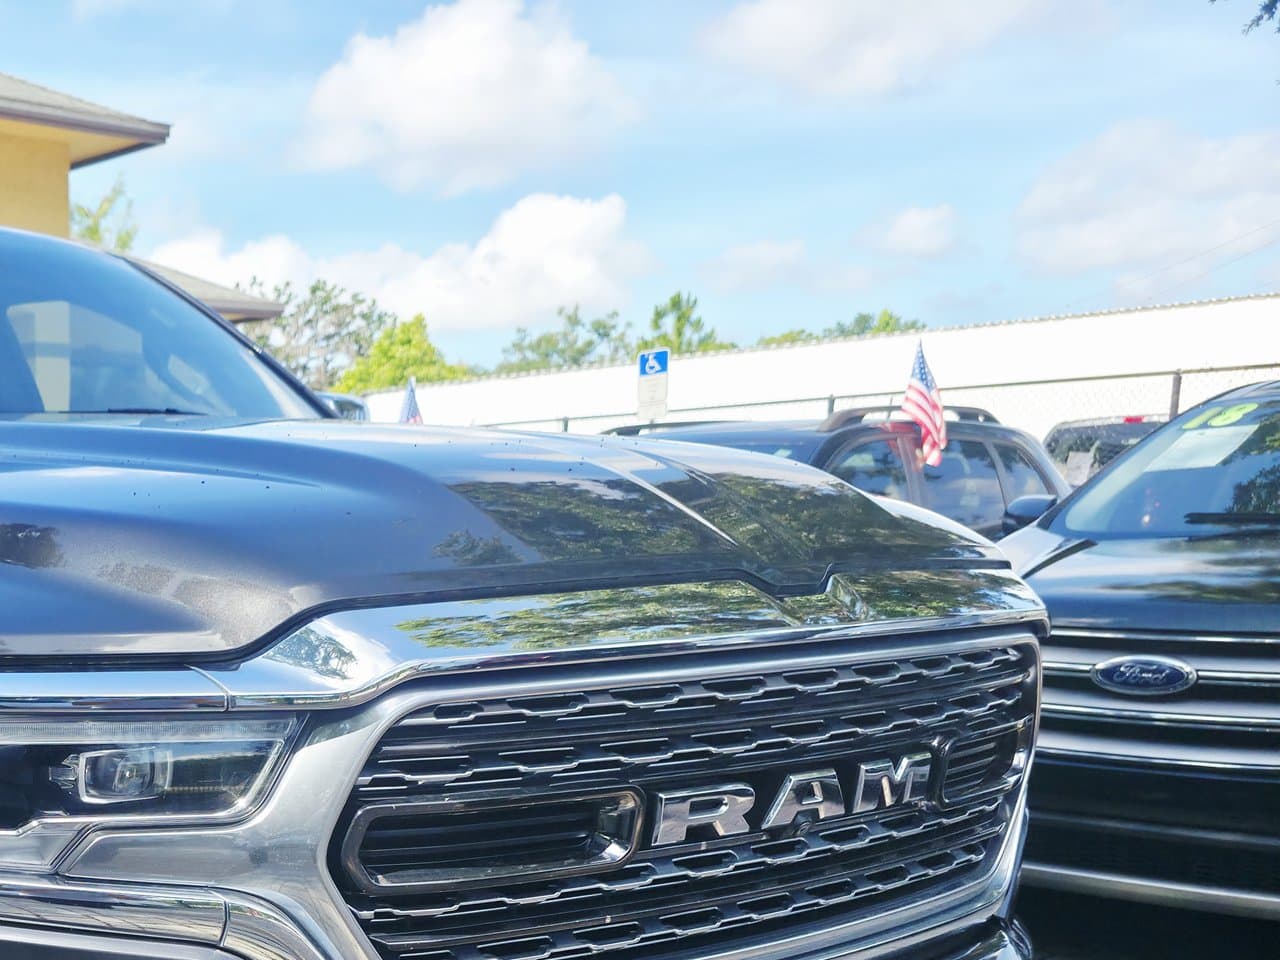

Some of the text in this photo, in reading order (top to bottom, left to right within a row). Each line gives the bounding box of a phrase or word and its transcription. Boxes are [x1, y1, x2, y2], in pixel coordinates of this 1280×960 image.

[1182, 403, 1258, 429] 18
[1113, 663, 1170, 684] Ford
[651, 752, 932, 846] RAM
